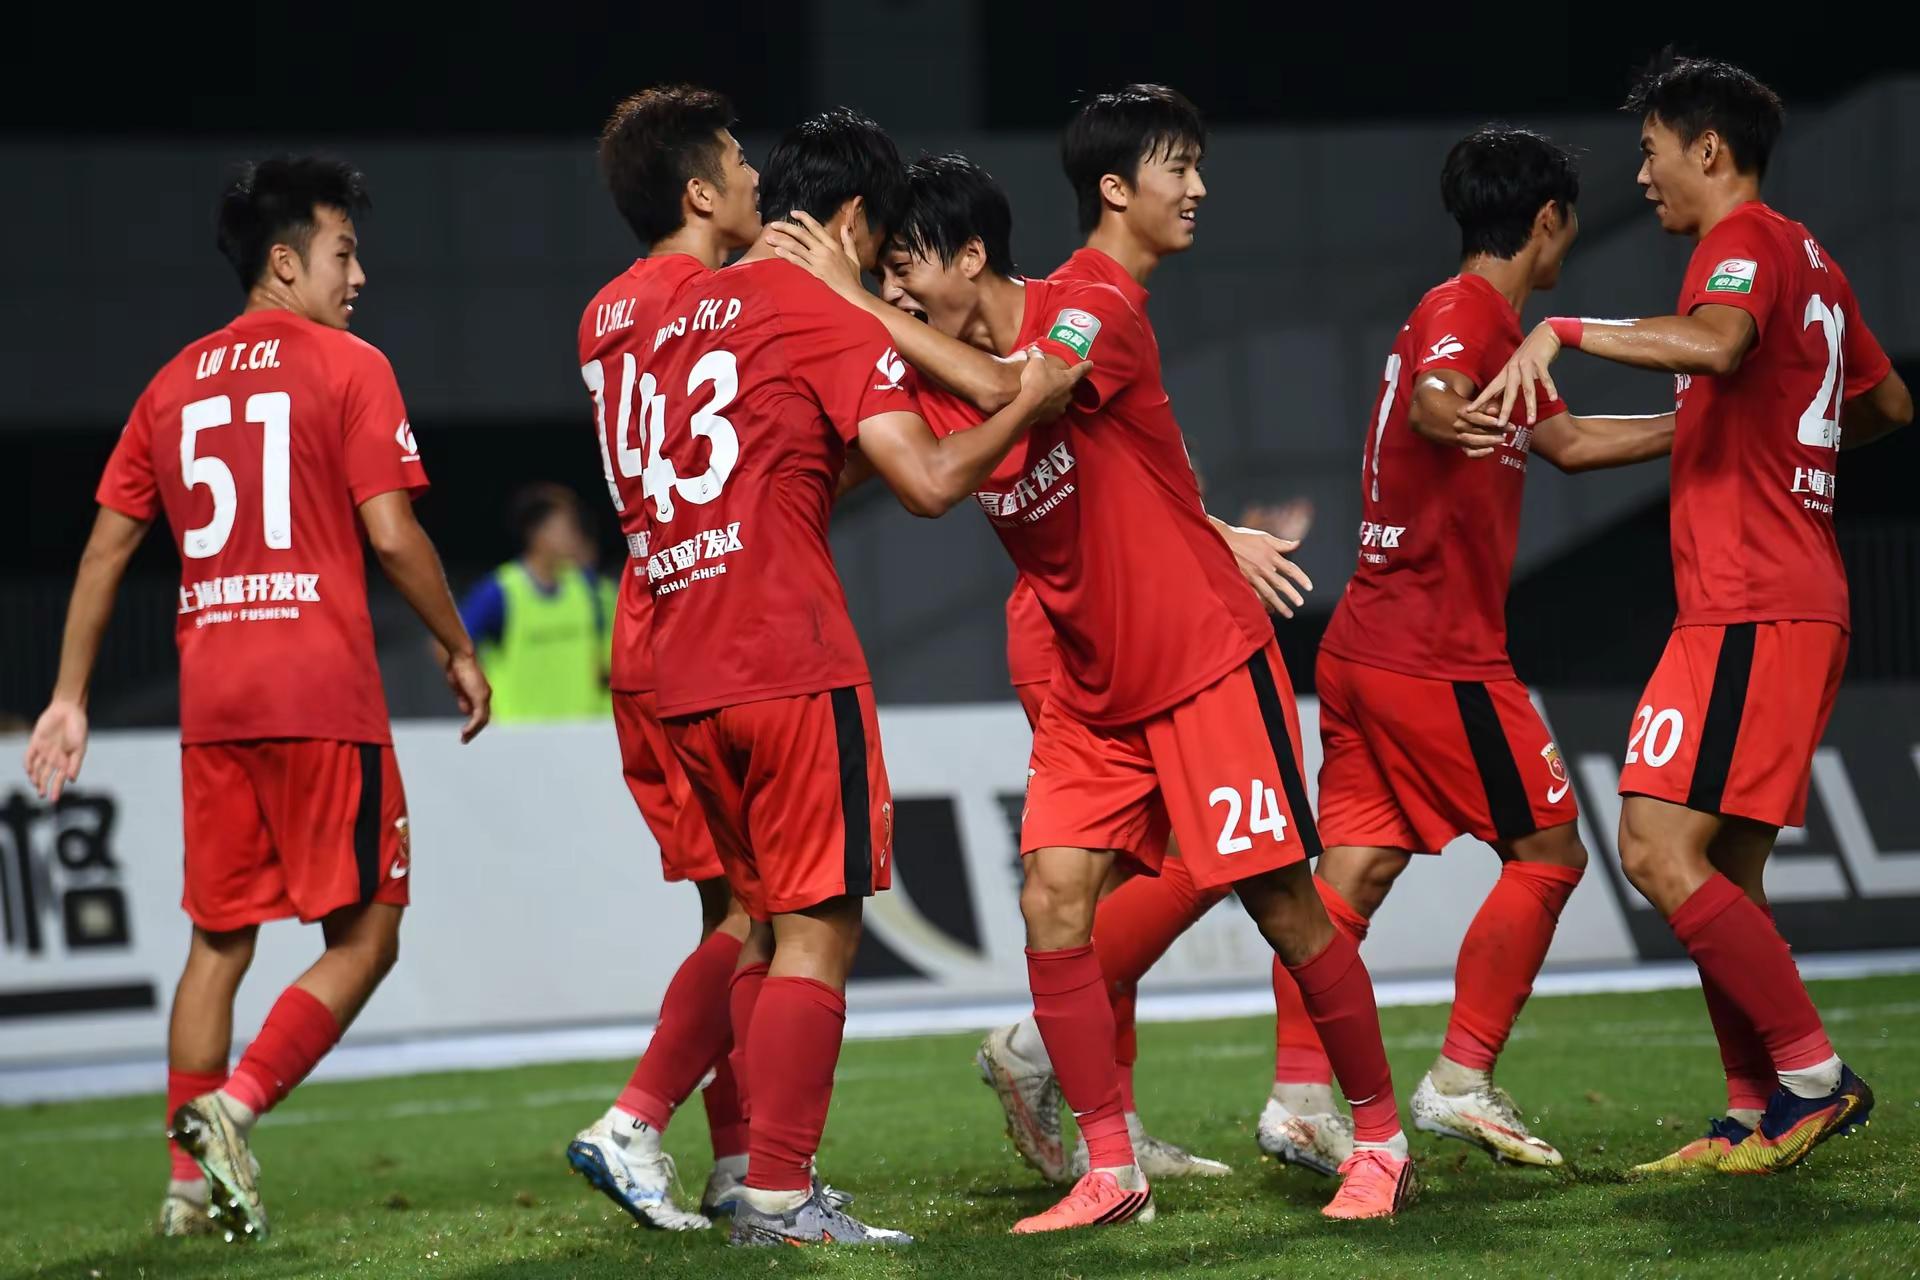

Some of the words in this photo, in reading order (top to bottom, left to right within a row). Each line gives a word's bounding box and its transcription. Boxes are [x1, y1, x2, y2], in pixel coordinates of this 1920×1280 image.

[196, 345, 227, 380] LIU
[230, 338, 281, 371] T.CH.
[639, 350, 740, 523] 43
[180, 391, 292, 559] 51
[1624, 705, 1684, 768] 20
[1208, 779, 1288, 855] 24
